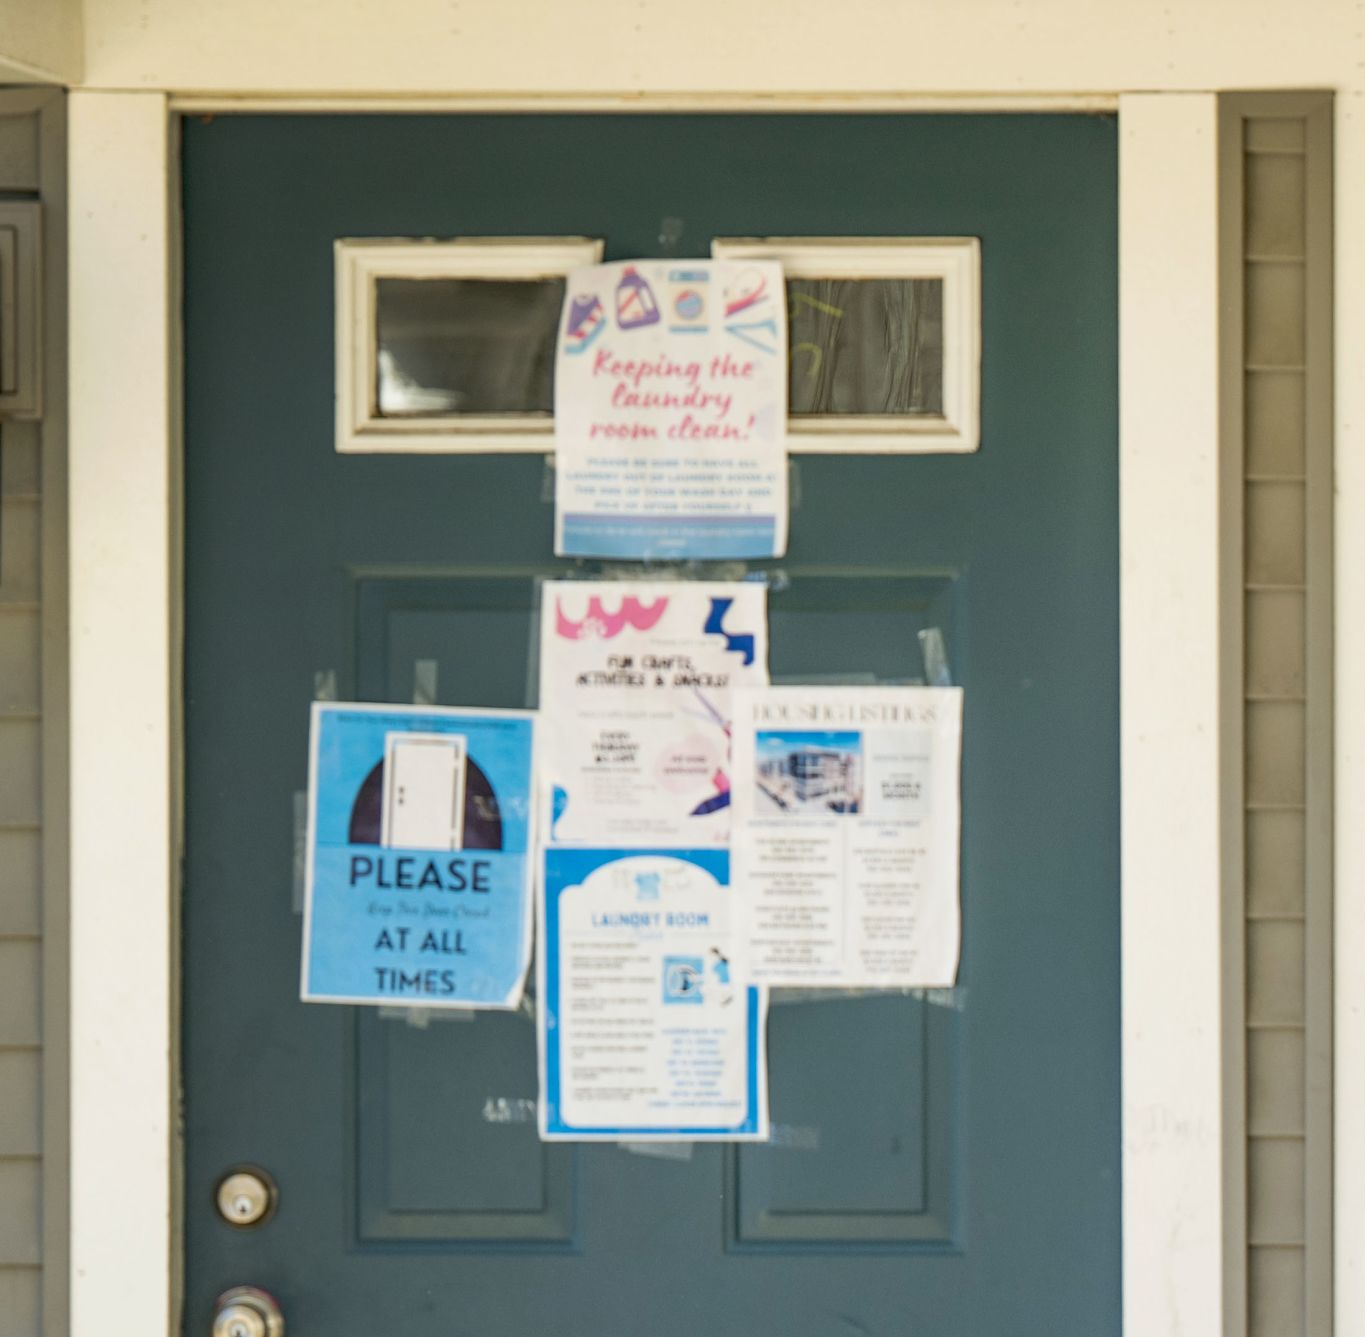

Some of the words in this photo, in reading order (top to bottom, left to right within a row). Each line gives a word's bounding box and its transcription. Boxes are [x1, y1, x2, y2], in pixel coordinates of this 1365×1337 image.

[592, 349, 701, 386] Keeping
[710, 354, 754, 378] the
[611, 383, 733, 419] laundry
[589, 423, 658, 440] room
[667, 414, 756, 440] clean!
[752, 704, 842, 721] HOUSING
[350, 856, 491, 893] PLEASE
[592, 912, 661, 928] LAUNDRY
[666, 912, 710, 927] ROOM
[374, 927, 410, 951] AT
[419, 928, 467, 954] ALL
[374, 967, 456, 995] TIMES
